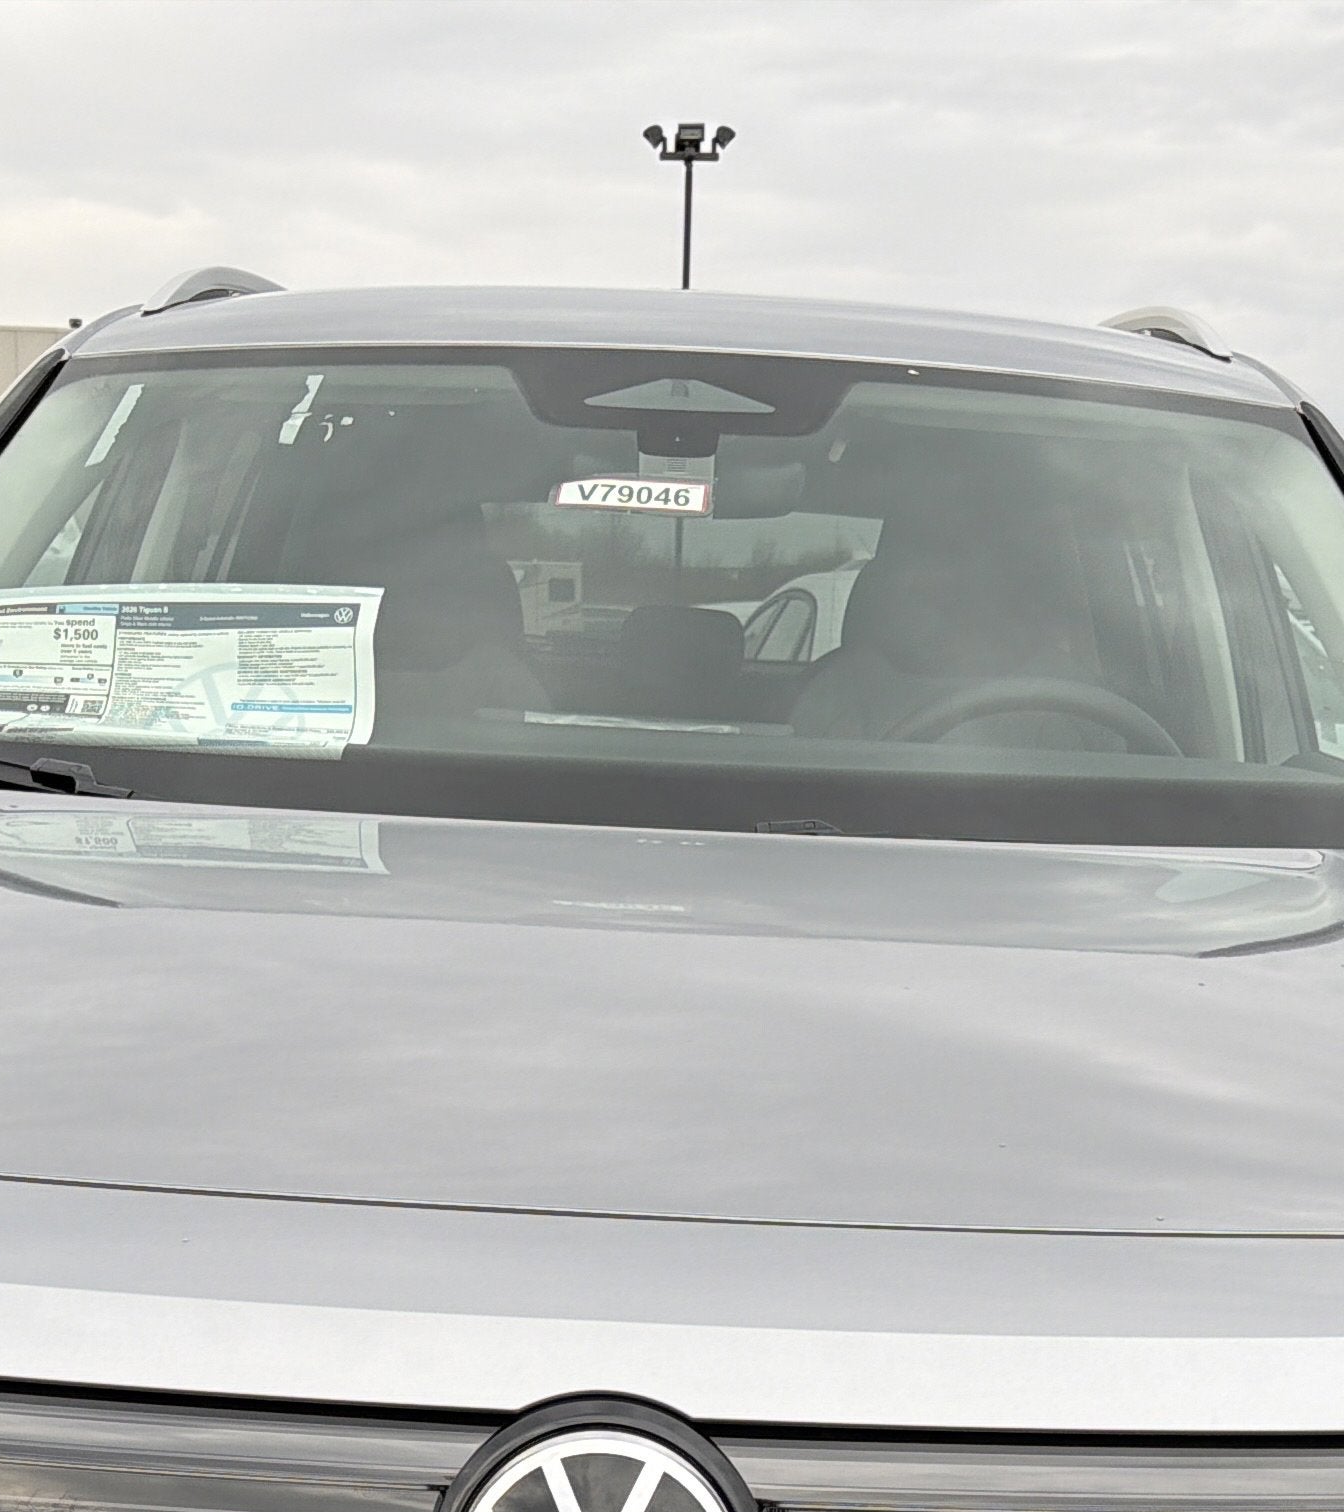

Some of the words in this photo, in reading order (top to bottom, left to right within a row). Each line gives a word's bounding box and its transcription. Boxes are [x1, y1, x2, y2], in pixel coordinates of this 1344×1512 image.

[577, 483, 691, 507] V79046
[66, 618, 96, 628] spend
[53, 628, 99, 642] $1,500
